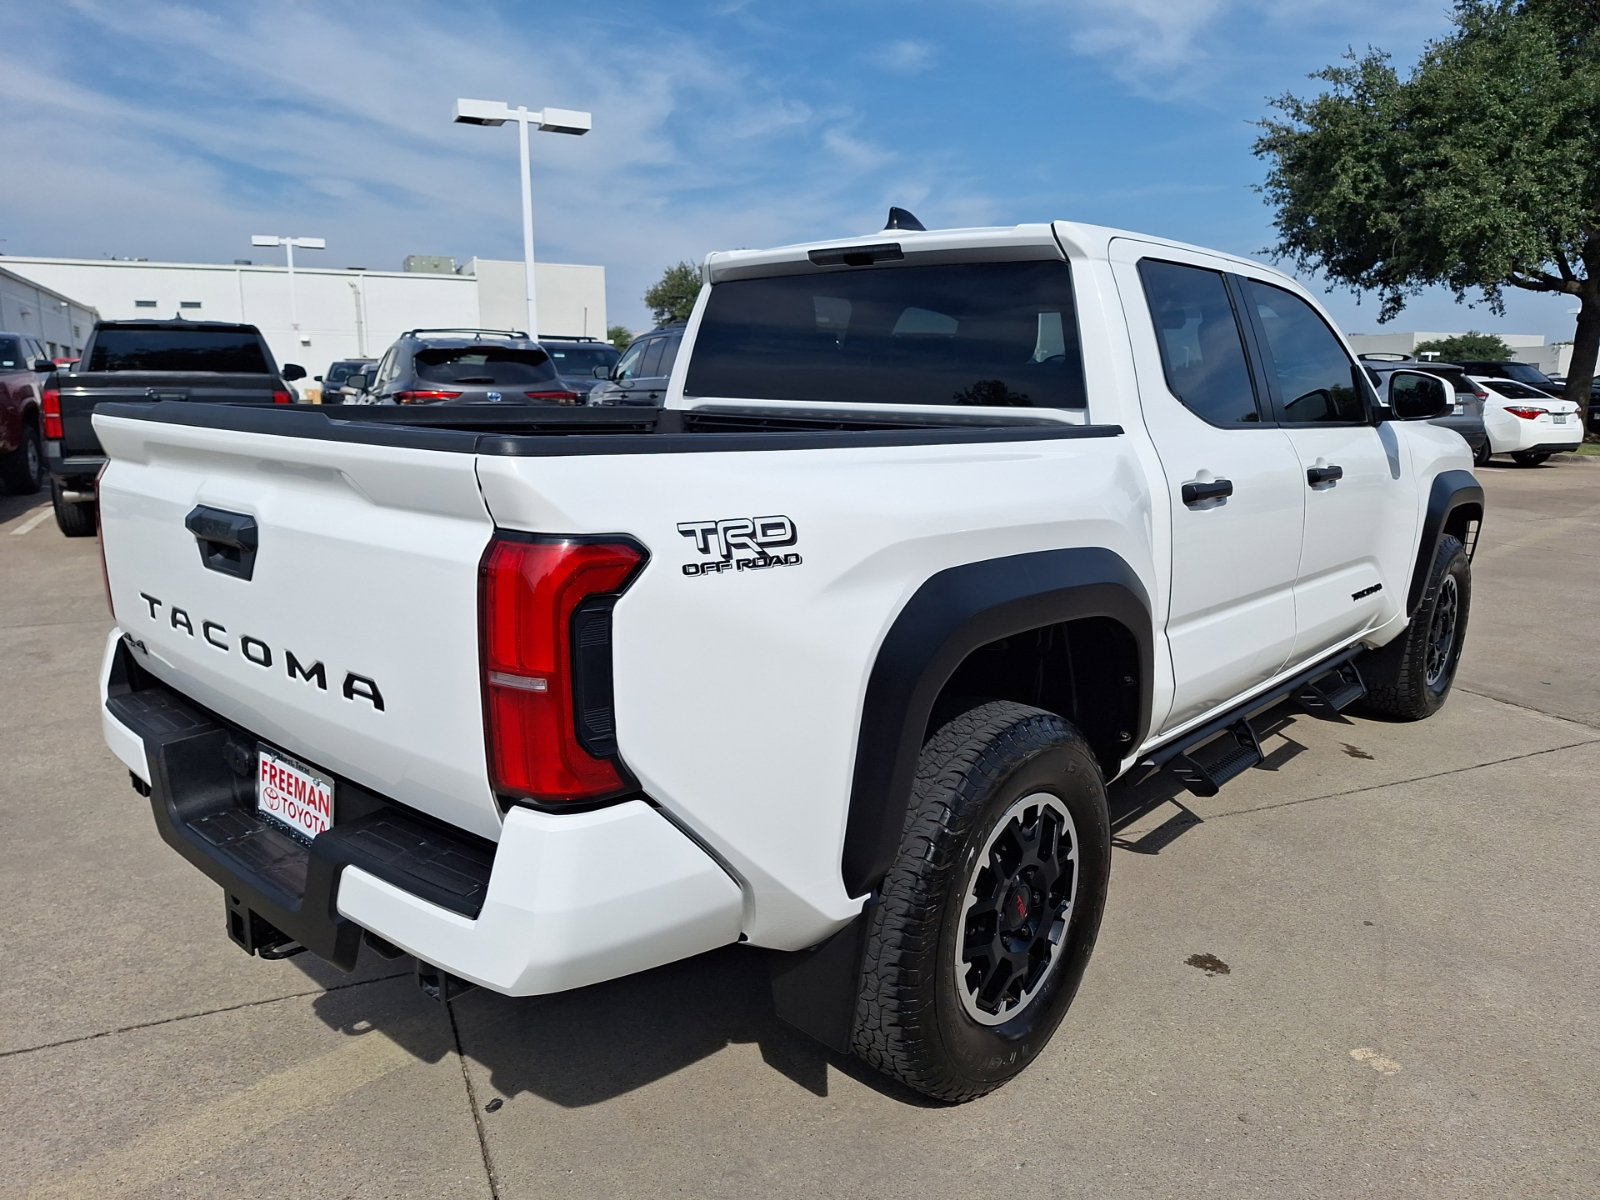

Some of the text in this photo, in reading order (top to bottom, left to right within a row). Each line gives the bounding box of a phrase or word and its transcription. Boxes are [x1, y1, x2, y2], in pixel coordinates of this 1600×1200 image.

[676, 514, 798, 560] TRD
[682, 553, 802, 577] OFF ROAD
[139, 590, 386, 712] TACOMA
[261, 760, 330, 818] FREEMAN
[281, 796, 326, 834] TOYOTA
